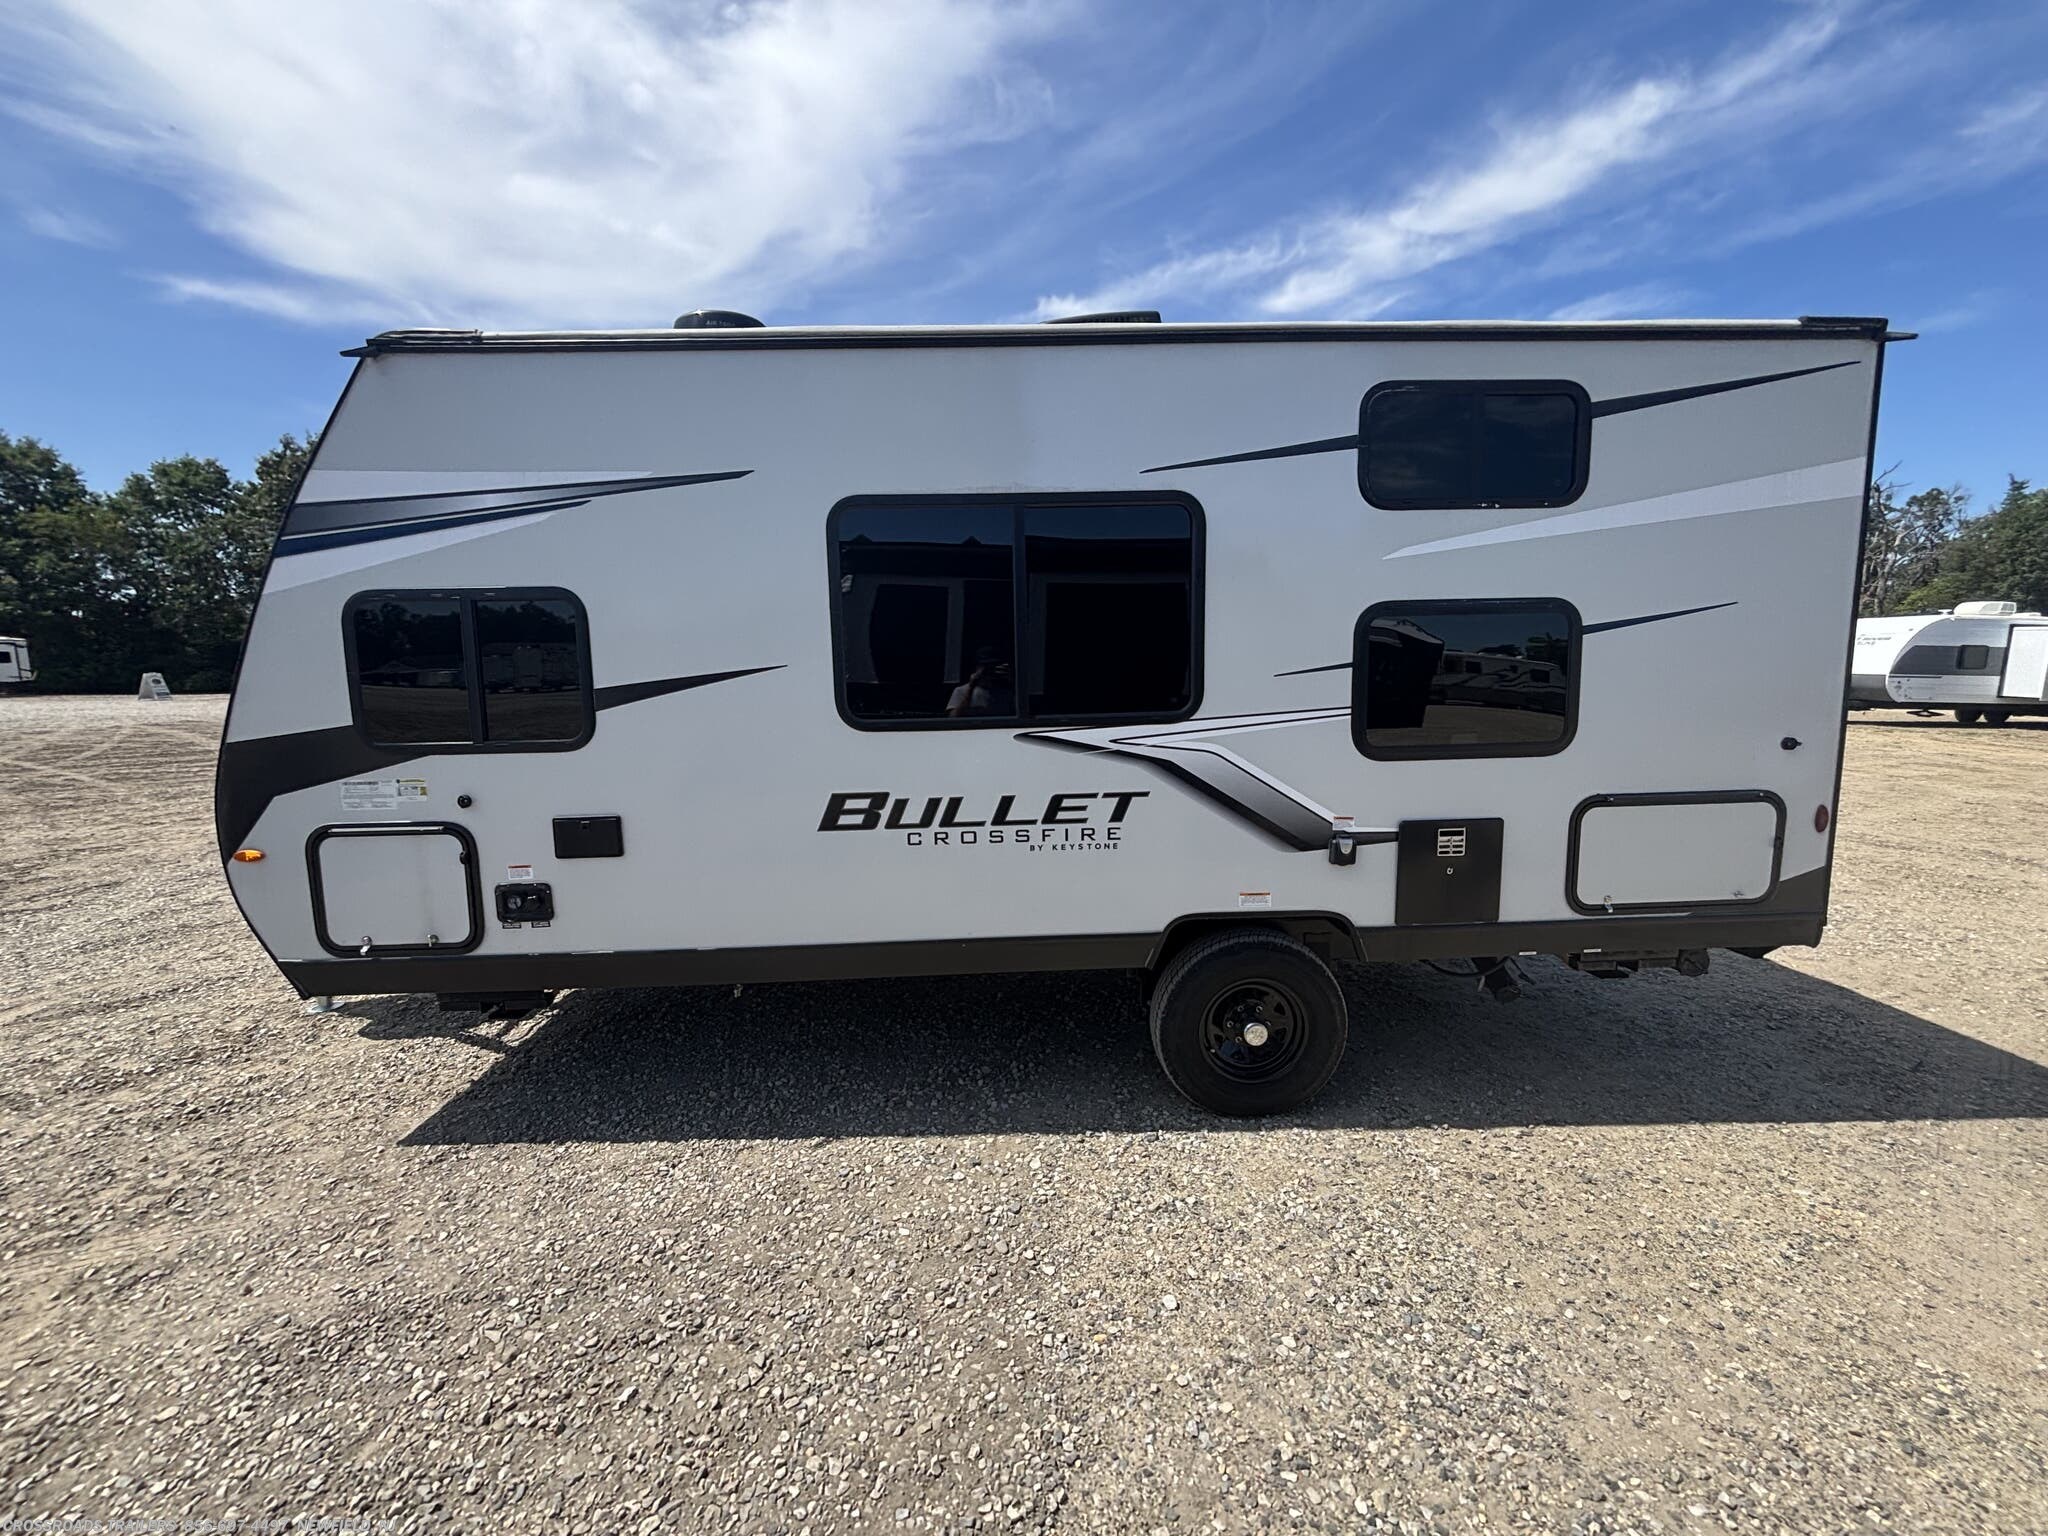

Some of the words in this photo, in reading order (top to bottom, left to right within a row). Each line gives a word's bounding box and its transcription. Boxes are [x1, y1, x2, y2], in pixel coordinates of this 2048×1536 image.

[906, 827, 1121, 846] CROSSFIRE
[1029, 844, 1045, 852] BY
[1051, 842, 1119, 851] KEYSTONE
